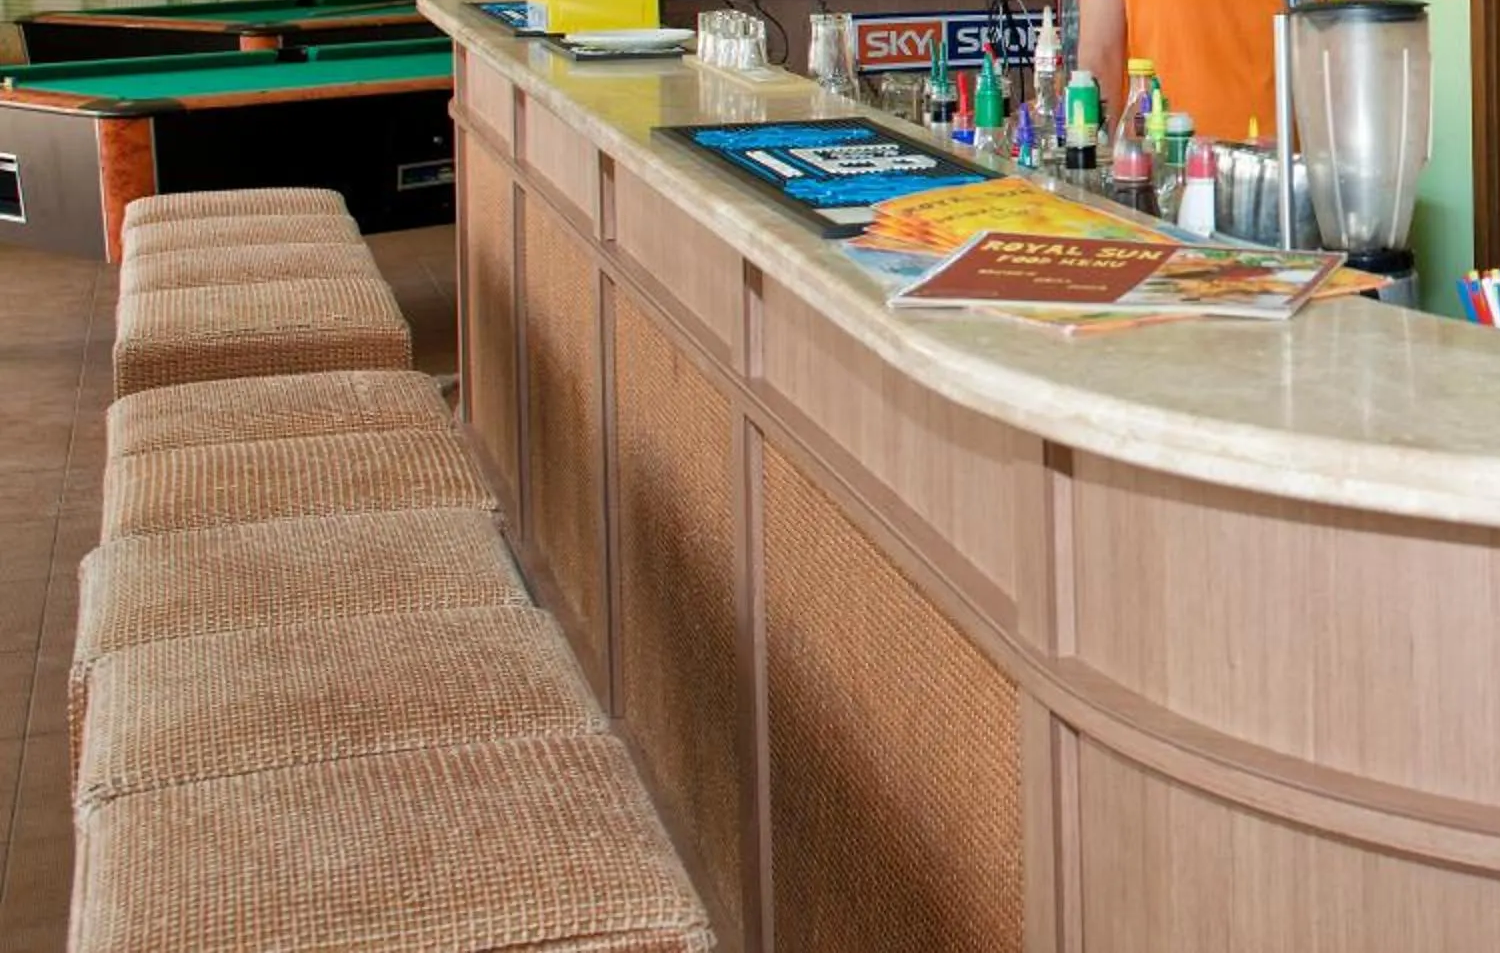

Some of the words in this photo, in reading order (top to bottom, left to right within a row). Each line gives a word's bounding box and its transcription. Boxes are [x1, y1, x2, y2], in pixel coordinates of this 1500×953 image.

[866, 28, 936, 59] SKY
[980, 240, 1083, 256] ROYAL
[1095, 247, 1165, 260] SUN
[1057, 257, 1128, 268] MENU
